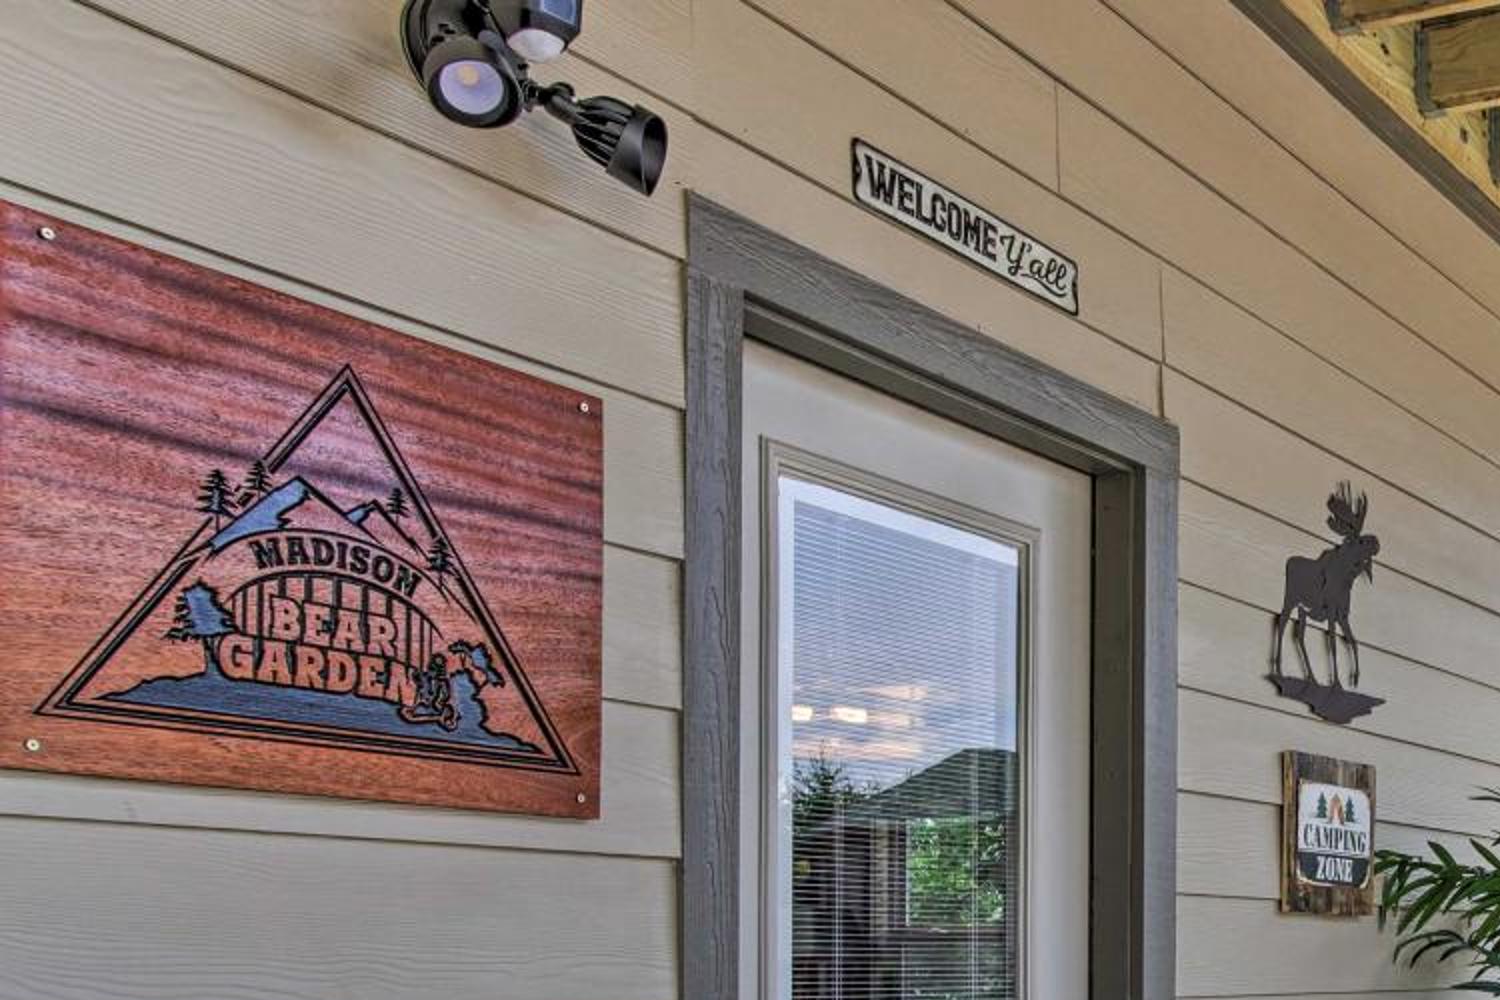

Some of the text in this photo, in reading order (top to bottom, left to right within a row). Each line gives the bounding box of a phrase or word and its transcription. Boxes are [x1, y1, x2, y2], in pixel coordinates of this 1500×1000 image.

[863, 153, 1067, 292] WELCOME Y'all
[251, 536, 423, 599] MADISON
[271, 597, 398, 656] BEAR
[219, 632, 417, 706] GARDEN
[1303, 823, 1367, 854] CAMPING
[1316, 856, 1353, 883] ZONE
